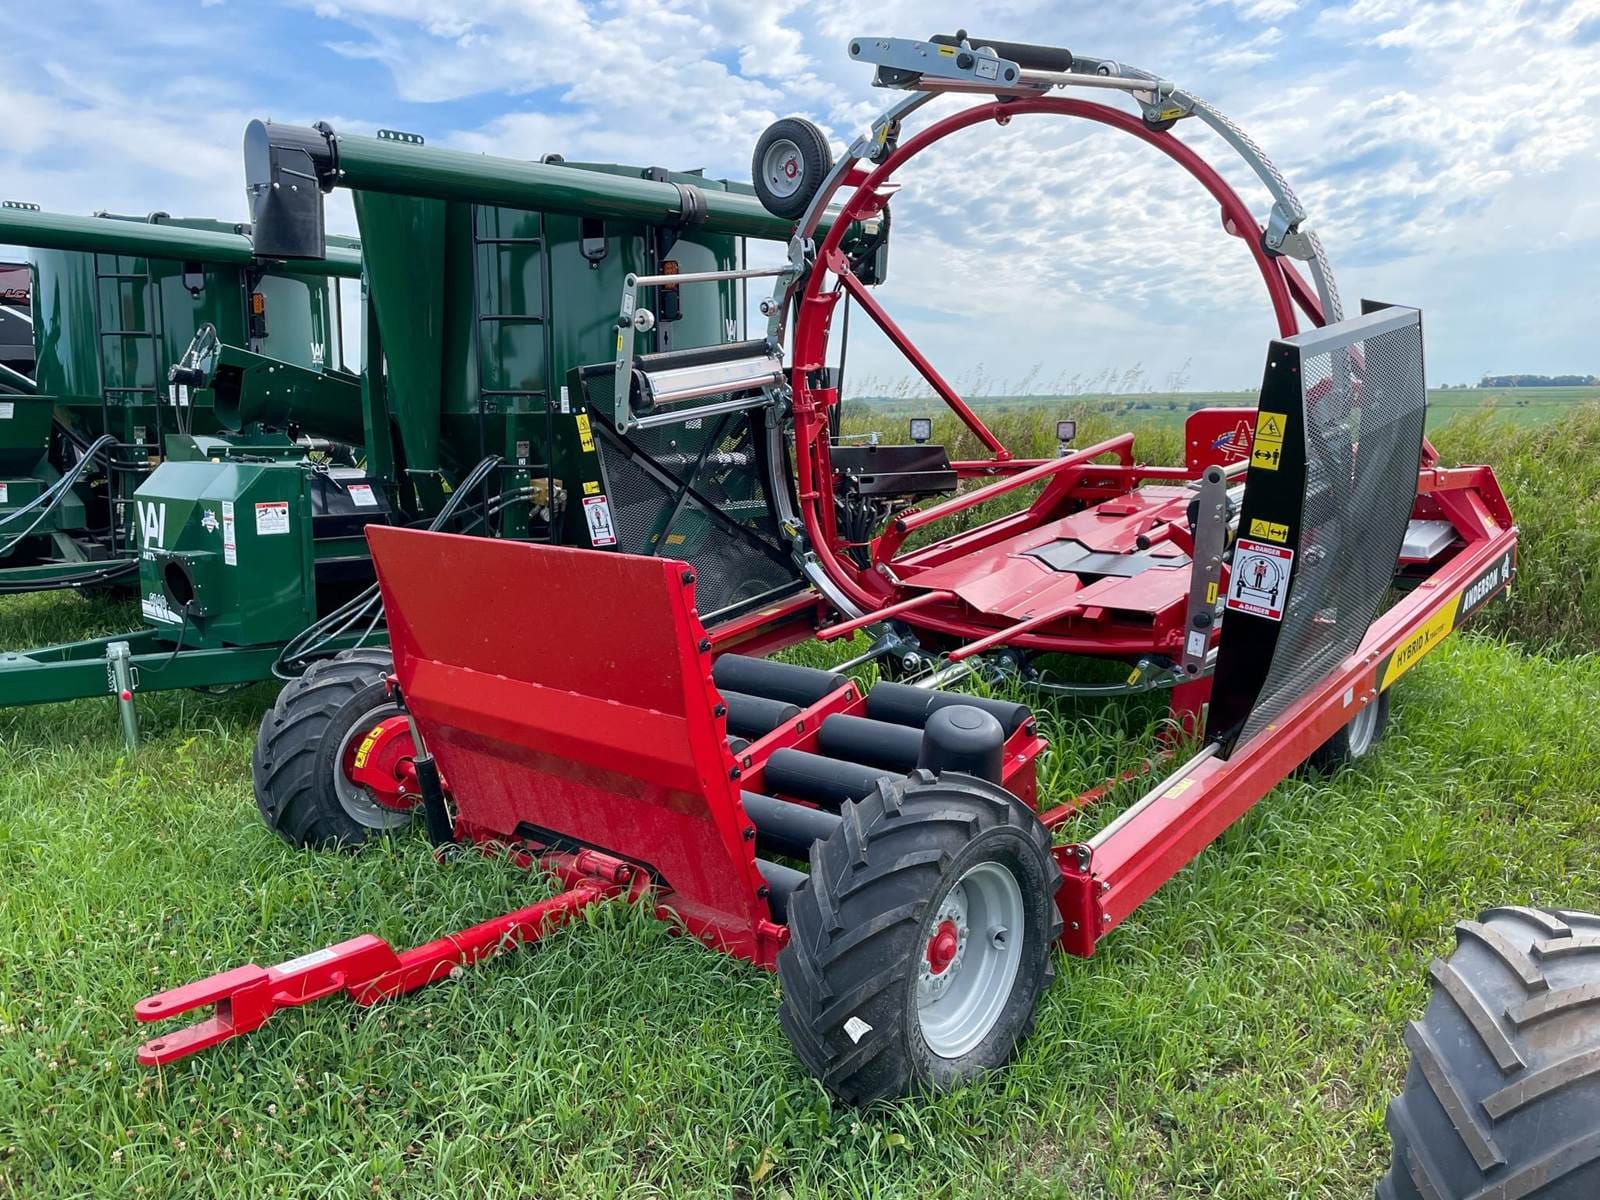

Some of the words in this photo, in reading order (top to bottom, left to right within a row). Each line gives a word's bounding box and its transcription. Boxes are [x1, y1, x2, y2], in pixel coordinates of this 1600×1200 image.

[1254, 544, 1281, 556] DANGER
[1462, 567, 1499, 614] ANDERSON
[1244, 604, 1270, 615] DANGER
[1397, 635, 1424, 669] HYBRID
[1424, 628, 1430, 645] X
